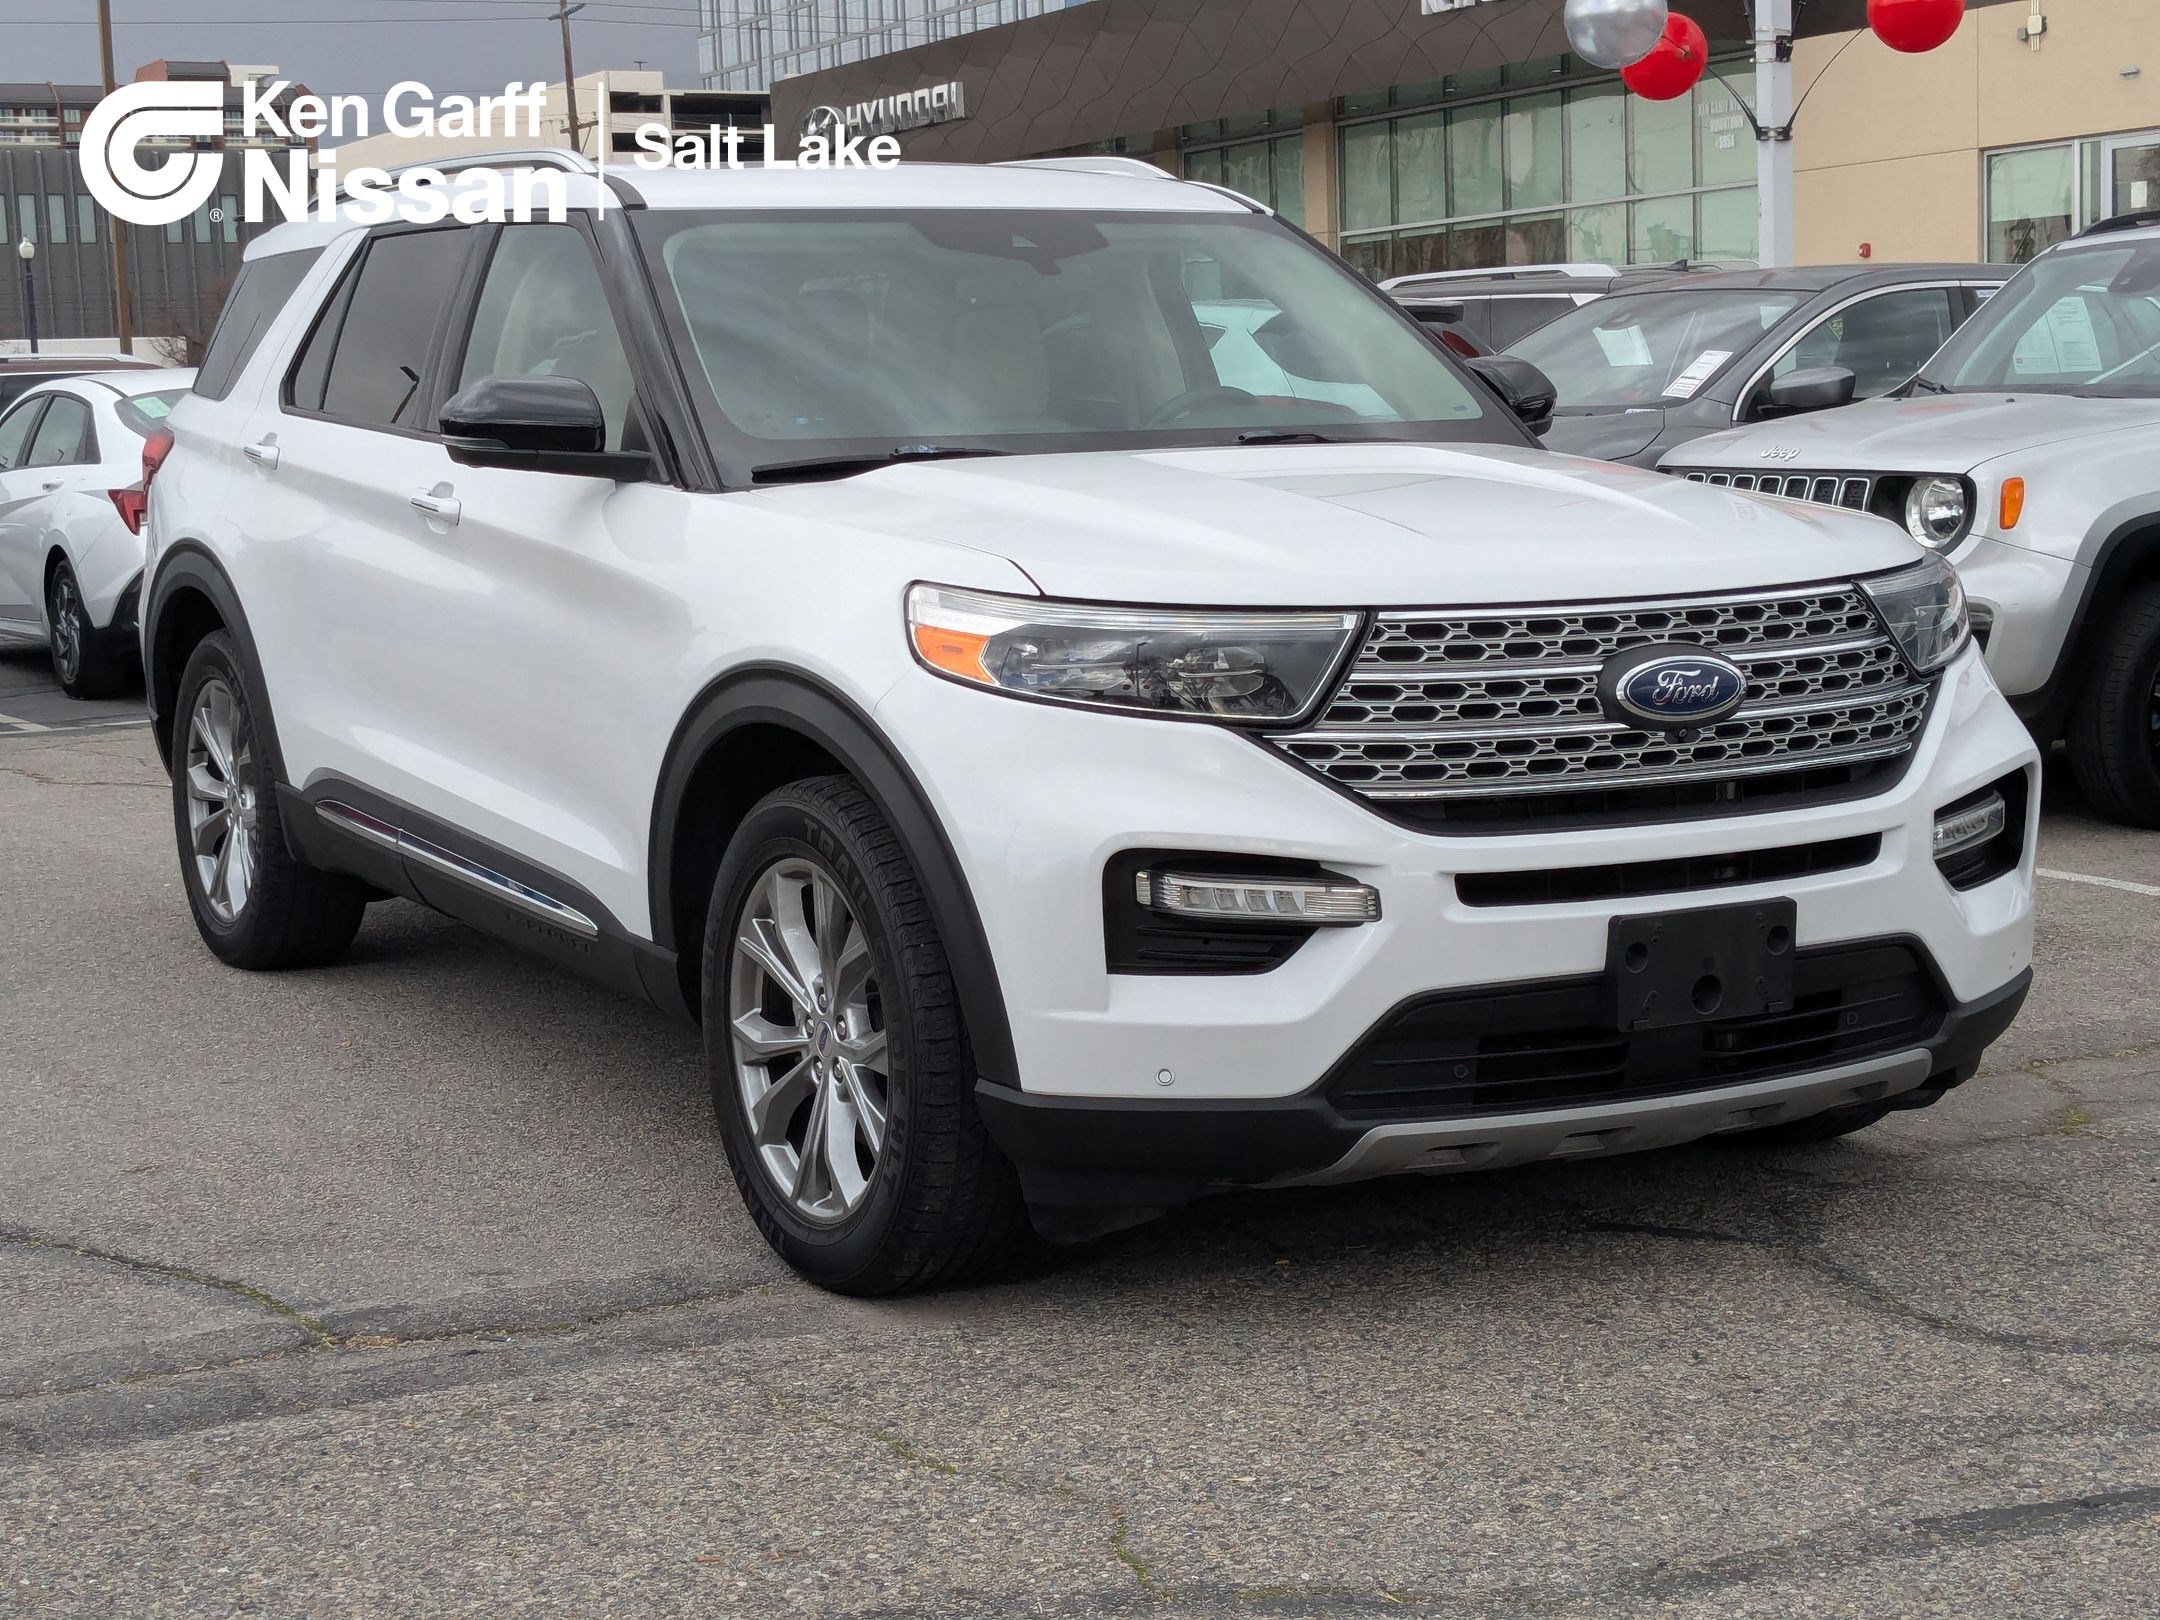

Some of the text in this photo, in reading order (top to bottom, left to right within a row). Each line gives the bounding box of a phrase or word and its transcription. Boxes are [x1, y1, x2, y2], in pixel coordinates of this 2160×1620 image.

[846, 81, 966, 137] HYUNDAI
[1760, 446, 1801, 461] Jeep
[1652, 669, 1719, 706] Ford
